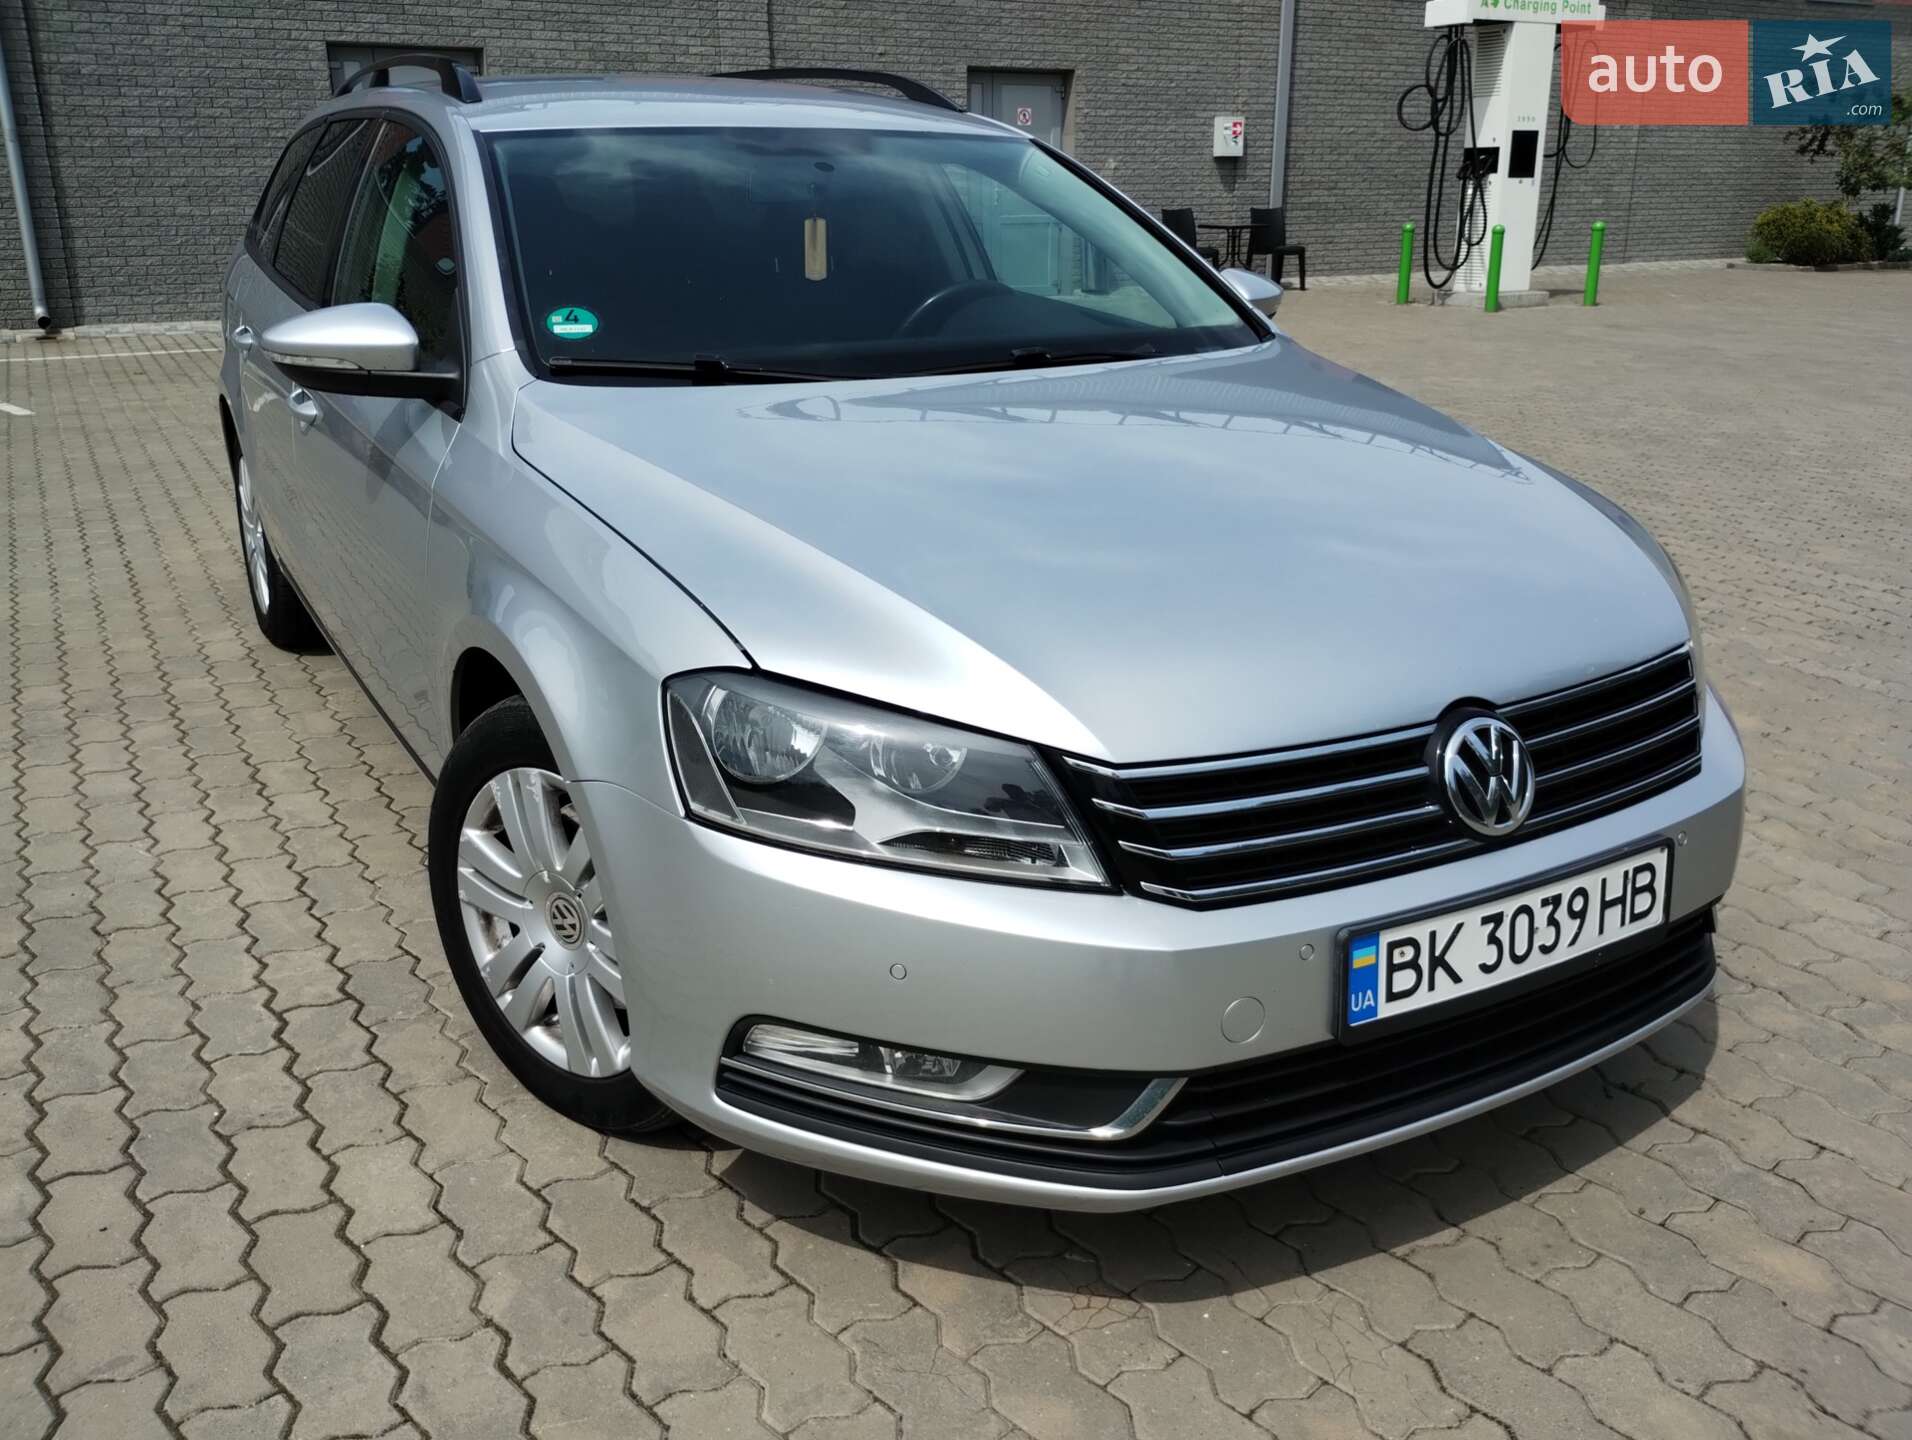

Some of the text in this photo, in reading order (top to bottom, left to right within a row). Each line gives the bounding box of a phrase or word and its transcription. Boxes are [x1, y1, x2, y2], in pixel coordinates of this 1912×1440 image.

[1504, 0, 1558, 14] Charging
[1562, 0, 1592, 14] Point
[564, 309, 580, 324] 4
[1385, 862, 1657, 1004] BK 3039 HB
[1351, 989, 1375, 1012] UA
